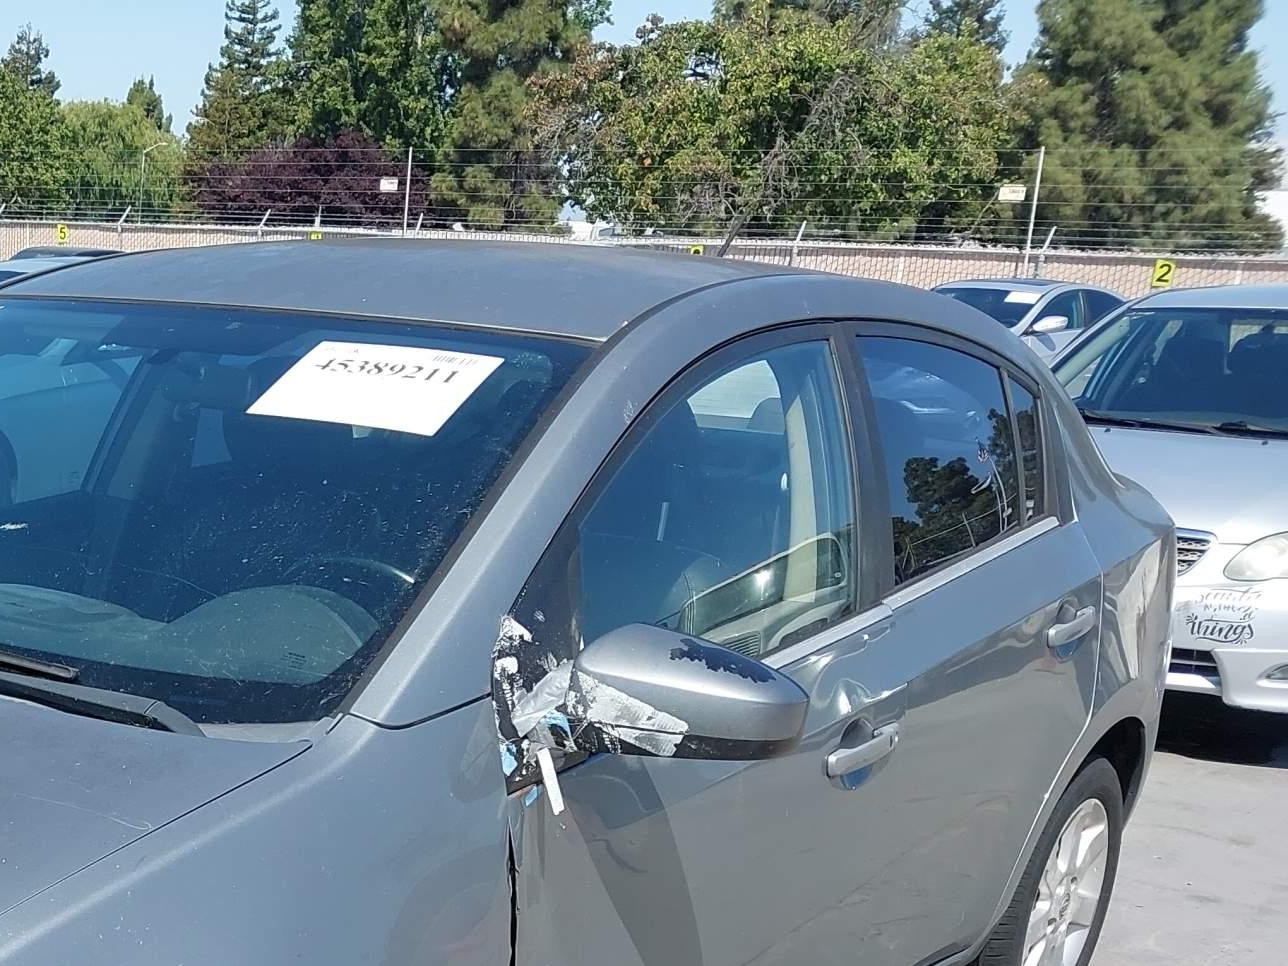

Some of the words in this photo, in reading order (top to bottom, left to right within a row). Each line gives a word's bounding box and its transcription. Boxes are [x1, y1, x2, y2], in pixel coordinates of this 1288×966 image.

[59, 226, 66, 240] 5
[1155, 263, 1172, 283] 2
[316, 358, 459, 383] 45389211
